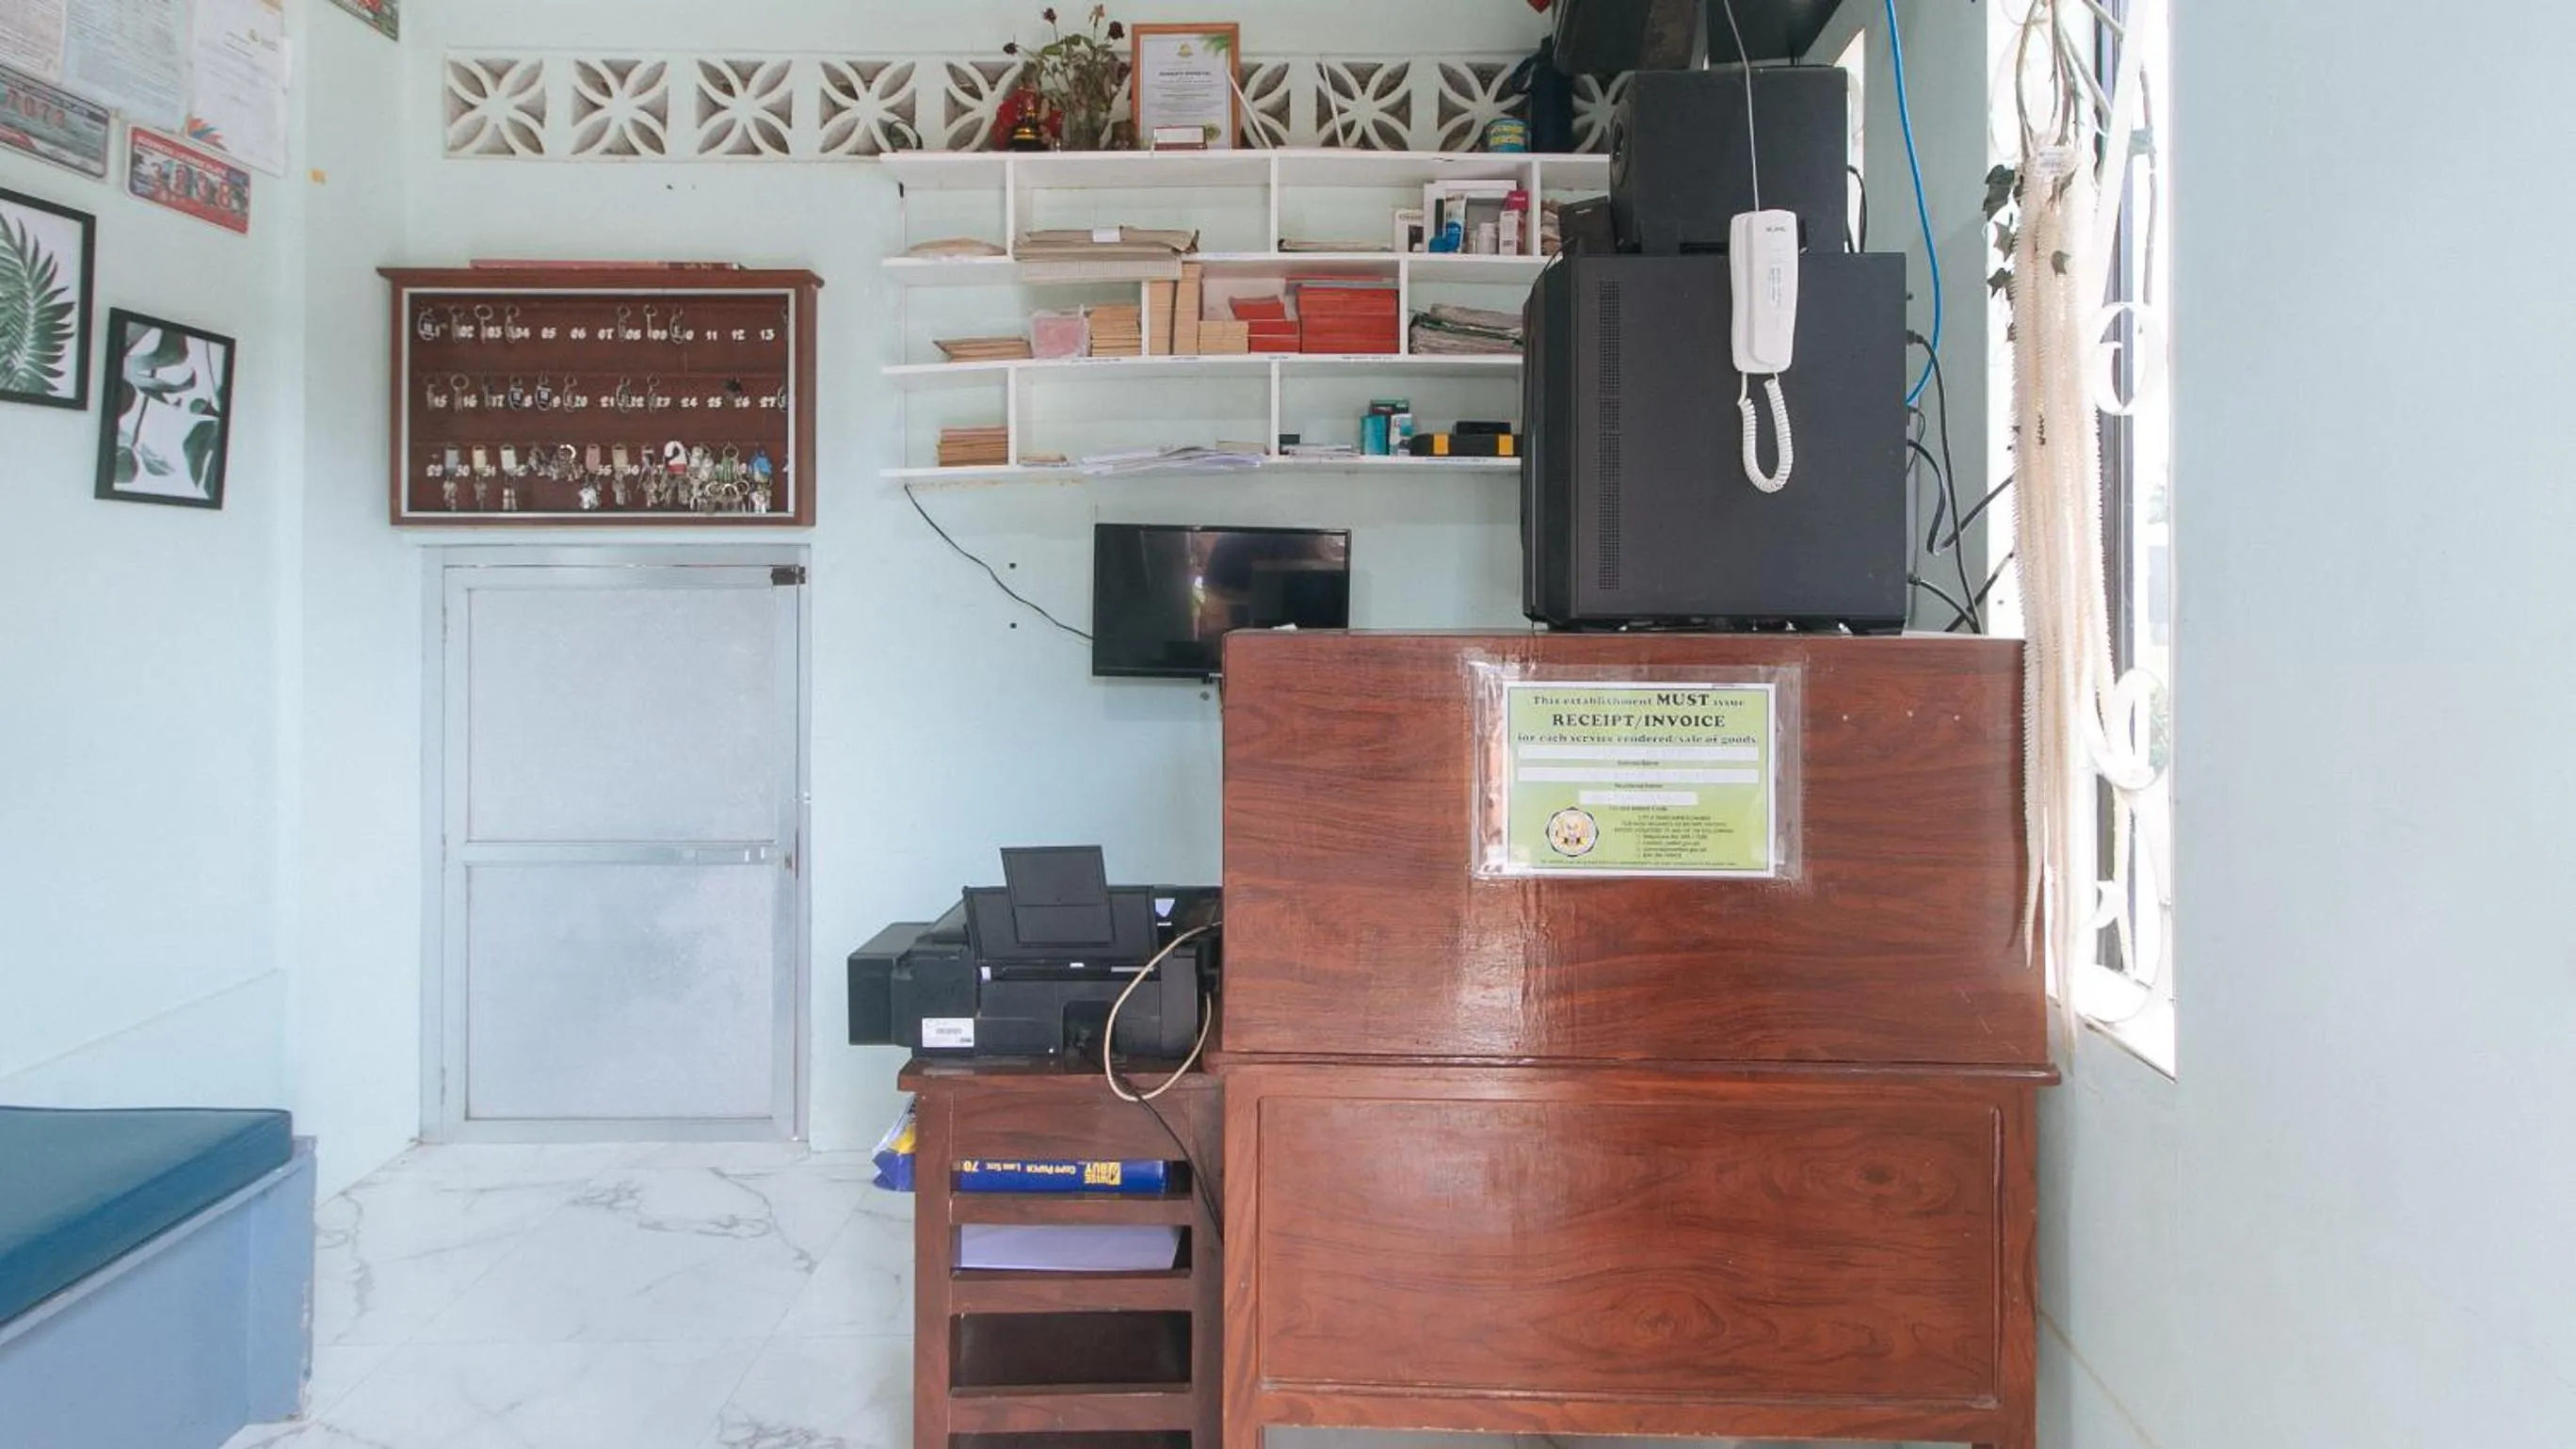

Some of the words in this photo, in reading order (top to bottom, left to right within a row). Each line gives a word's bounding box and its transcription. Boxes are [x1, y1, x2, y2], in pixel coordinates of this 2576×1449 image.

[459, 326, 475, 338] 02
[540, 327, 557, 339] 05
[570, 328, 587, 340] 06
[597, 329, 614, 340] 07
[625, 330, 641, 340] 08
[652, 330, 668, 340] 09
[705, 330, 718, 341] 11
[731, 330, 746, 341] 12
[760, 330, 776, 341] 13
[462, 394, 477, 408] 16
[600, 395, 614, 408] 21
[680, 395, 699, 408] 24
[706, 395, 723, 408] 25
[734, 395, 751, 408] 26
[759, 395, 777, 408] 27
[1534, 695, 1559, 705] This
[1562, 696, 1651, 705] establishment
[1656, 693, 1711, 706] MUST
[1553, 714, 1726, 730] RECEIPT/INVOICE
[1517, 733, 1535, 742] for
[1539, 733, 1568, 742] each
[1570, 733, 1614, 743] service
